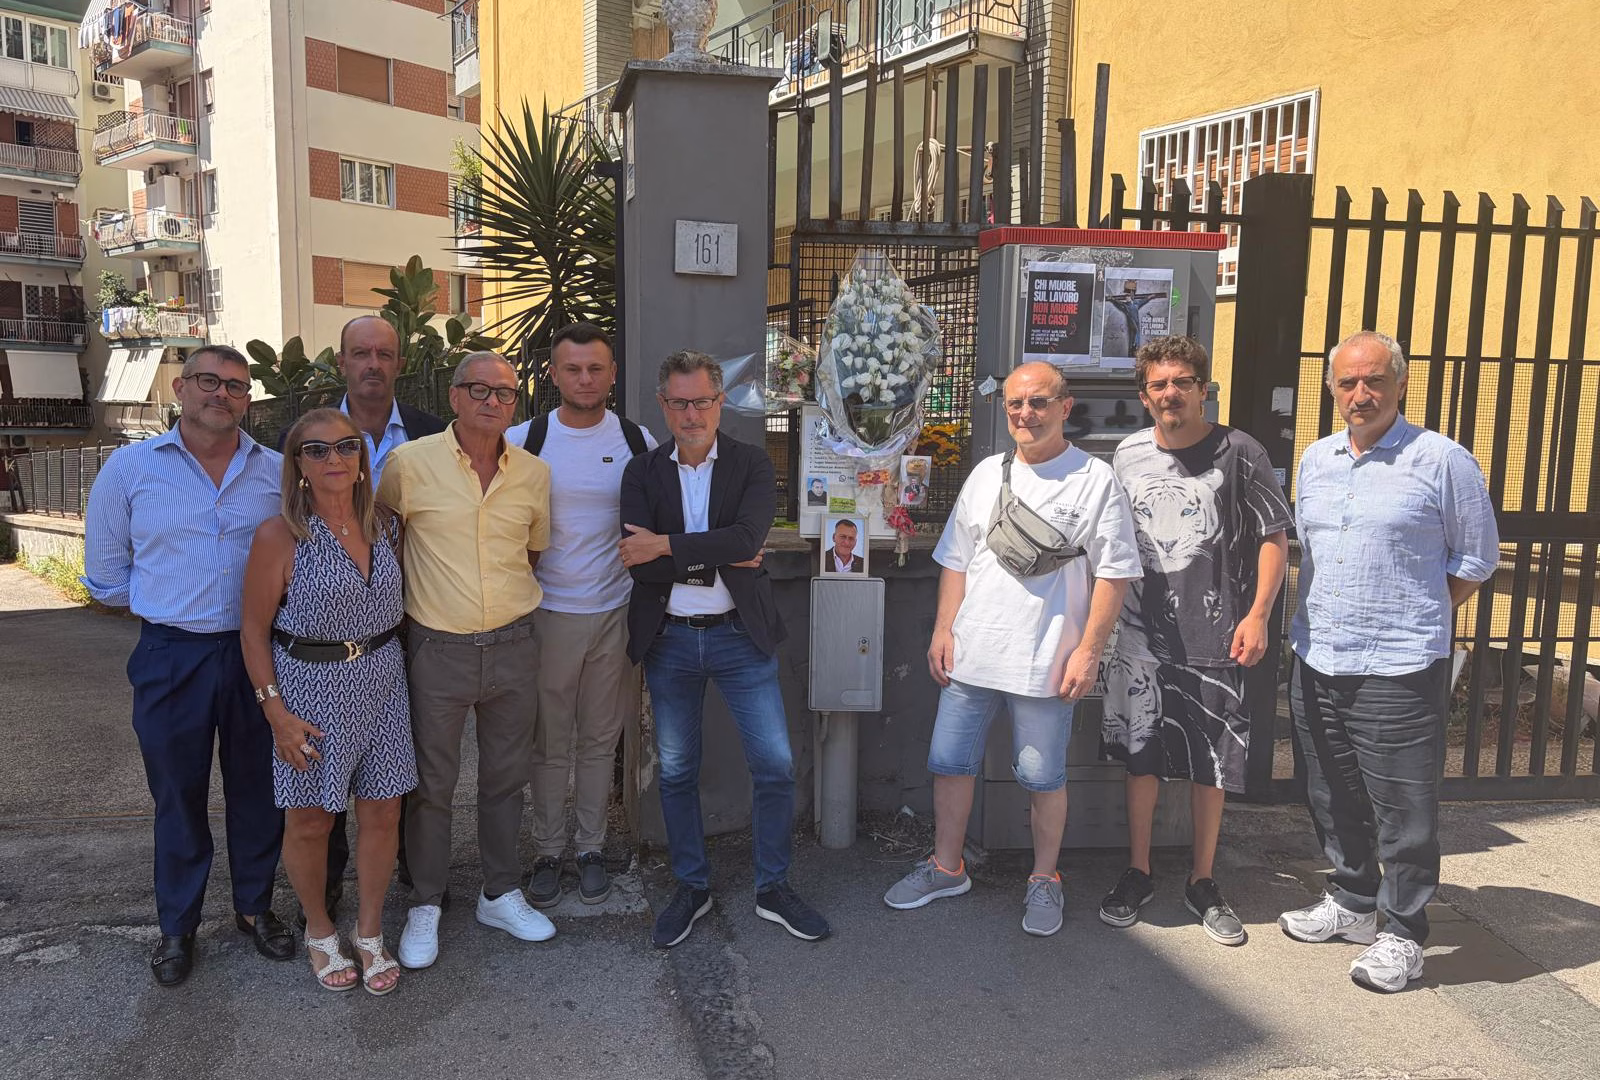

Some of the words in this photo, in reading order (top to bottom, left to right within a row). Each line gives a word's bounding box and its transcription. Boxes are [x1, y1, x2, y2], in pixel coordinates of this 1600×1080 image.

[695, 233, 720, 265] 161
[1034, 279, 1048, 290] CHI
[1048, 280, 1077, 291] MUORE
[1033, 291, 1048, 302] SUL
[1049, 292, 1079, 303] LAVORO
[1033, 302, 1049, 313] NON
[1050, 303, 1078, 314] MUORE
[1032, 314, 1047, 325] PER
[1048, 315, 1069, 325] CASO
